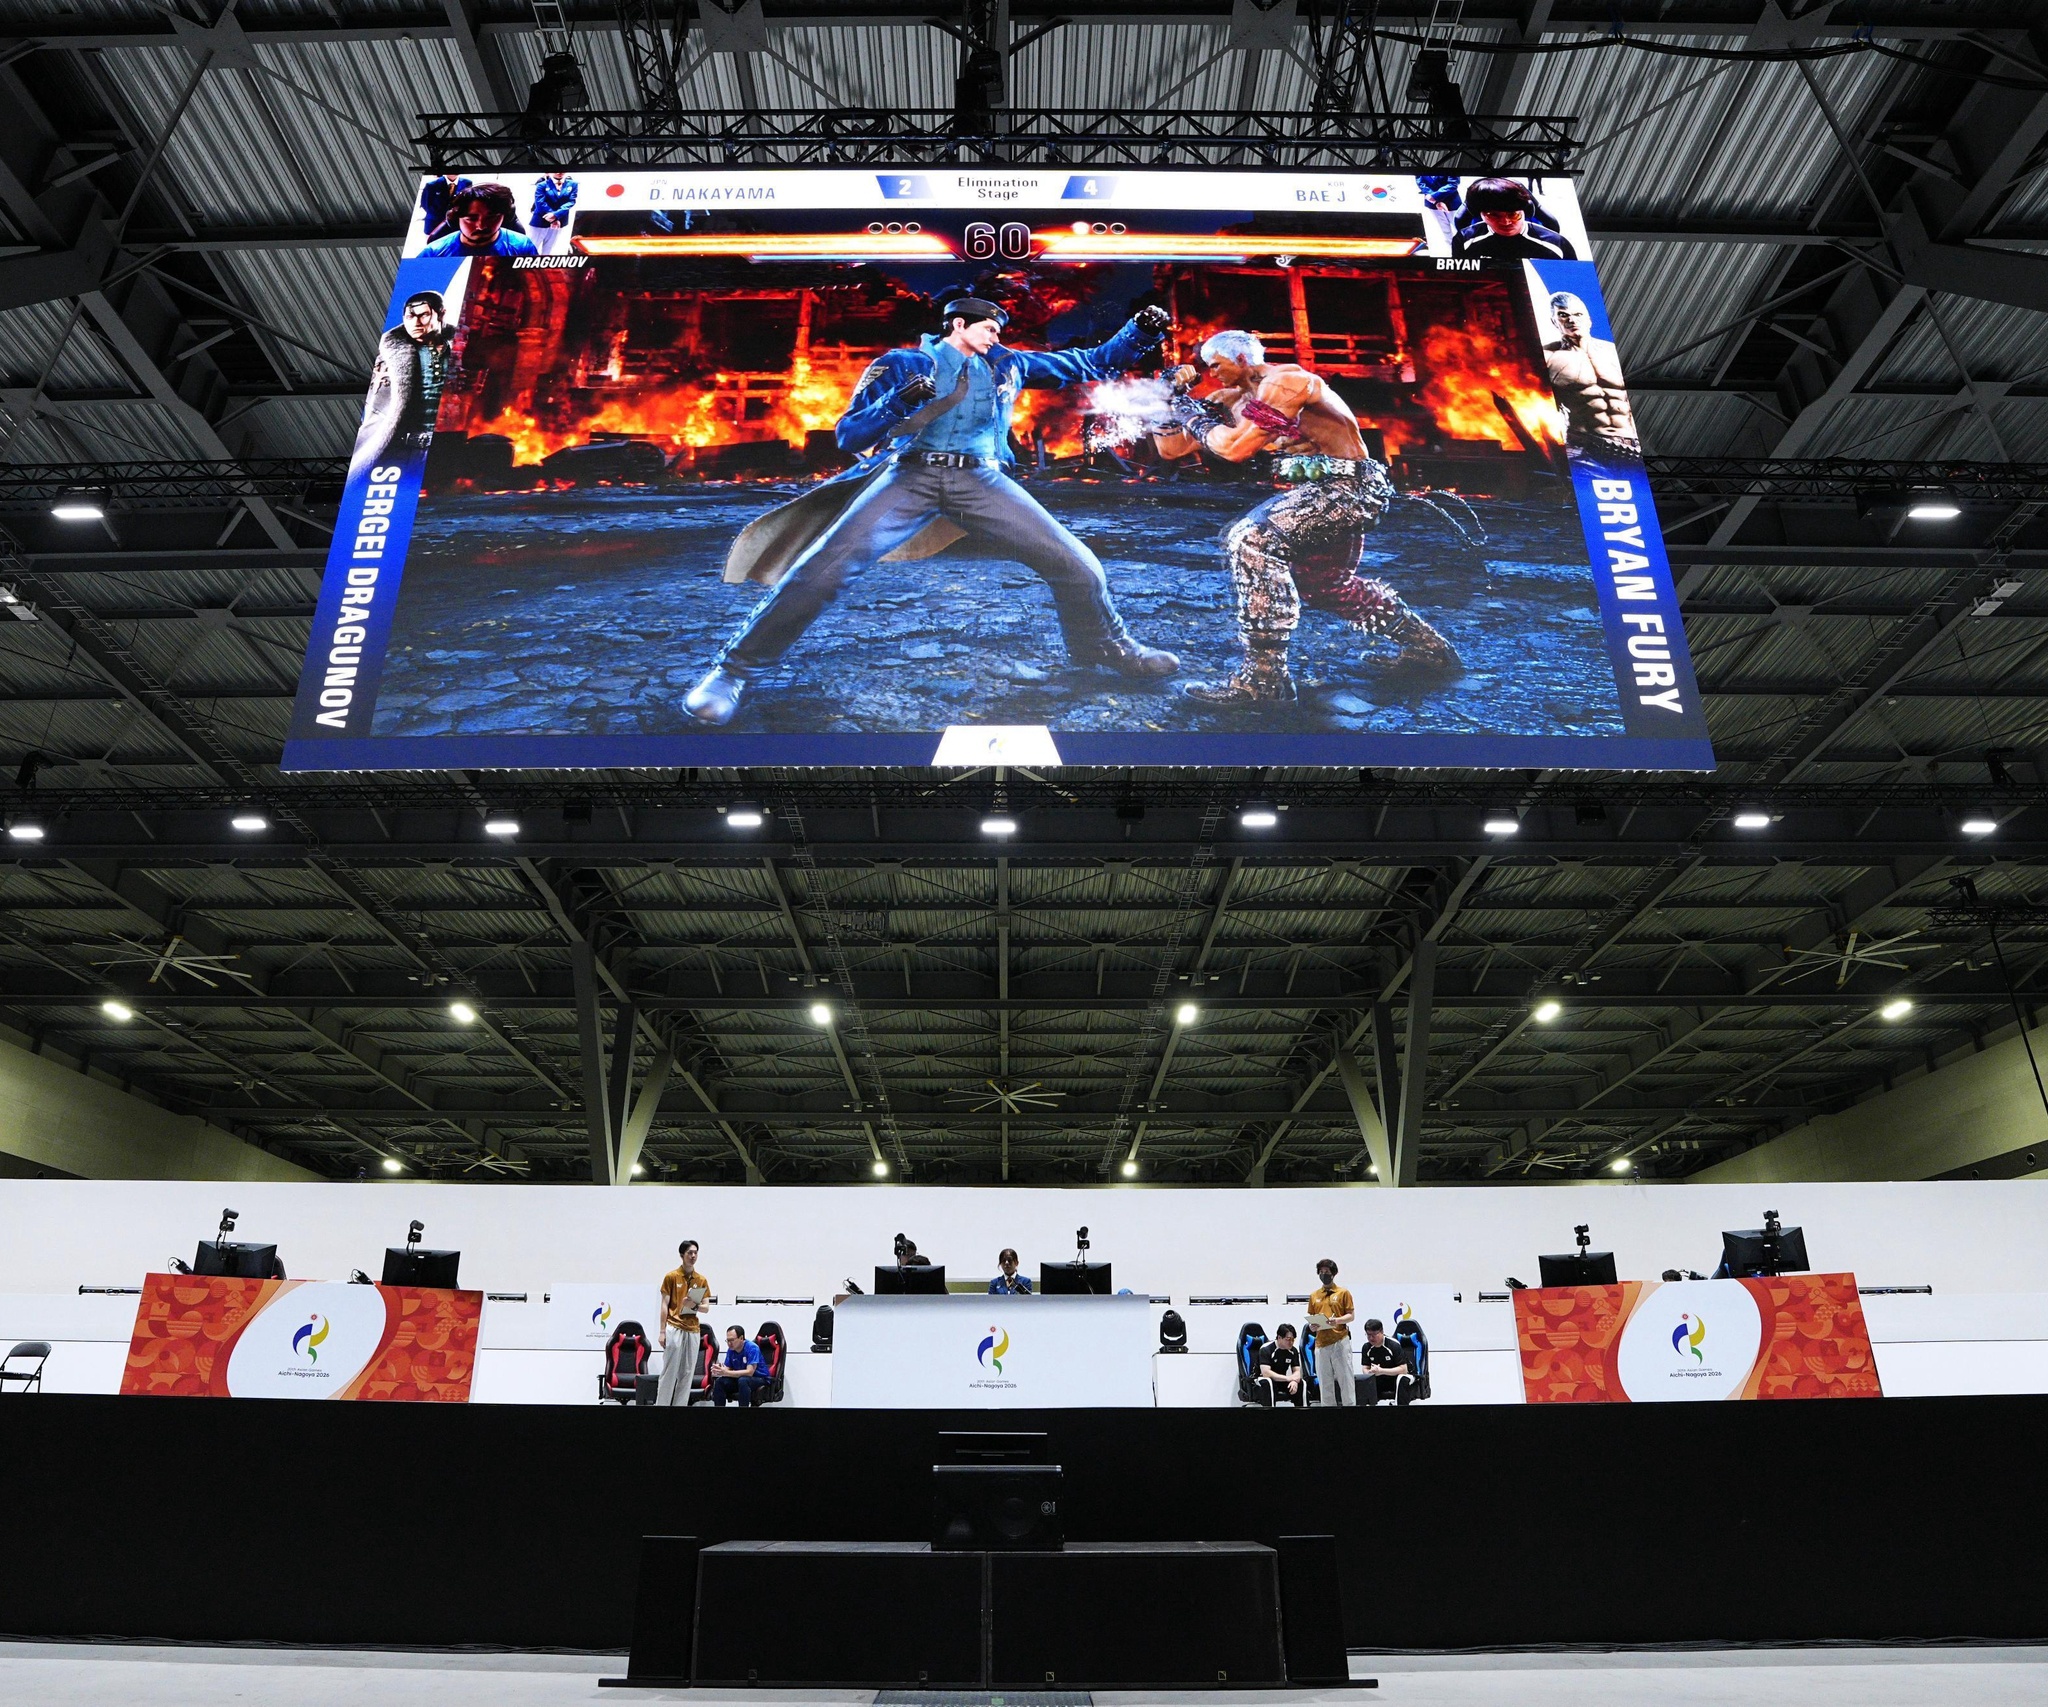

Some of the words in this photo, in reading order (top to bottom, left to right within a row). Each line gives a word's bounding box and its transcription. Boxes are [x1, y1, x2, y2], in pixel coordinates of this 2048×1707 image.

[898, 179, 912, 195] 2
[958, 176, 1038, 187] Elimination
[1083, 179, 1098, 196] 4
[649, 188, 665, 200] D.
[672, 187, 775, 200] NAKAYAMA
[977, 188, 1019, 201] Stage
[1296, 189, 1330, 202] BAE
[1337, 190, 1346, 202] J
[964, 221, 1031, 260] 60
[512, 256, 589, 269] DRAGUNOV
[1436, 258, 1481, 271] BRYAN
[352, 466, 401, 559] SERGEI
[1591, 479, 1658, 601] BRYAN
[315, 567, 379, 729] DRAGUNOV
[1621, 613, 1684, 714] FURY
